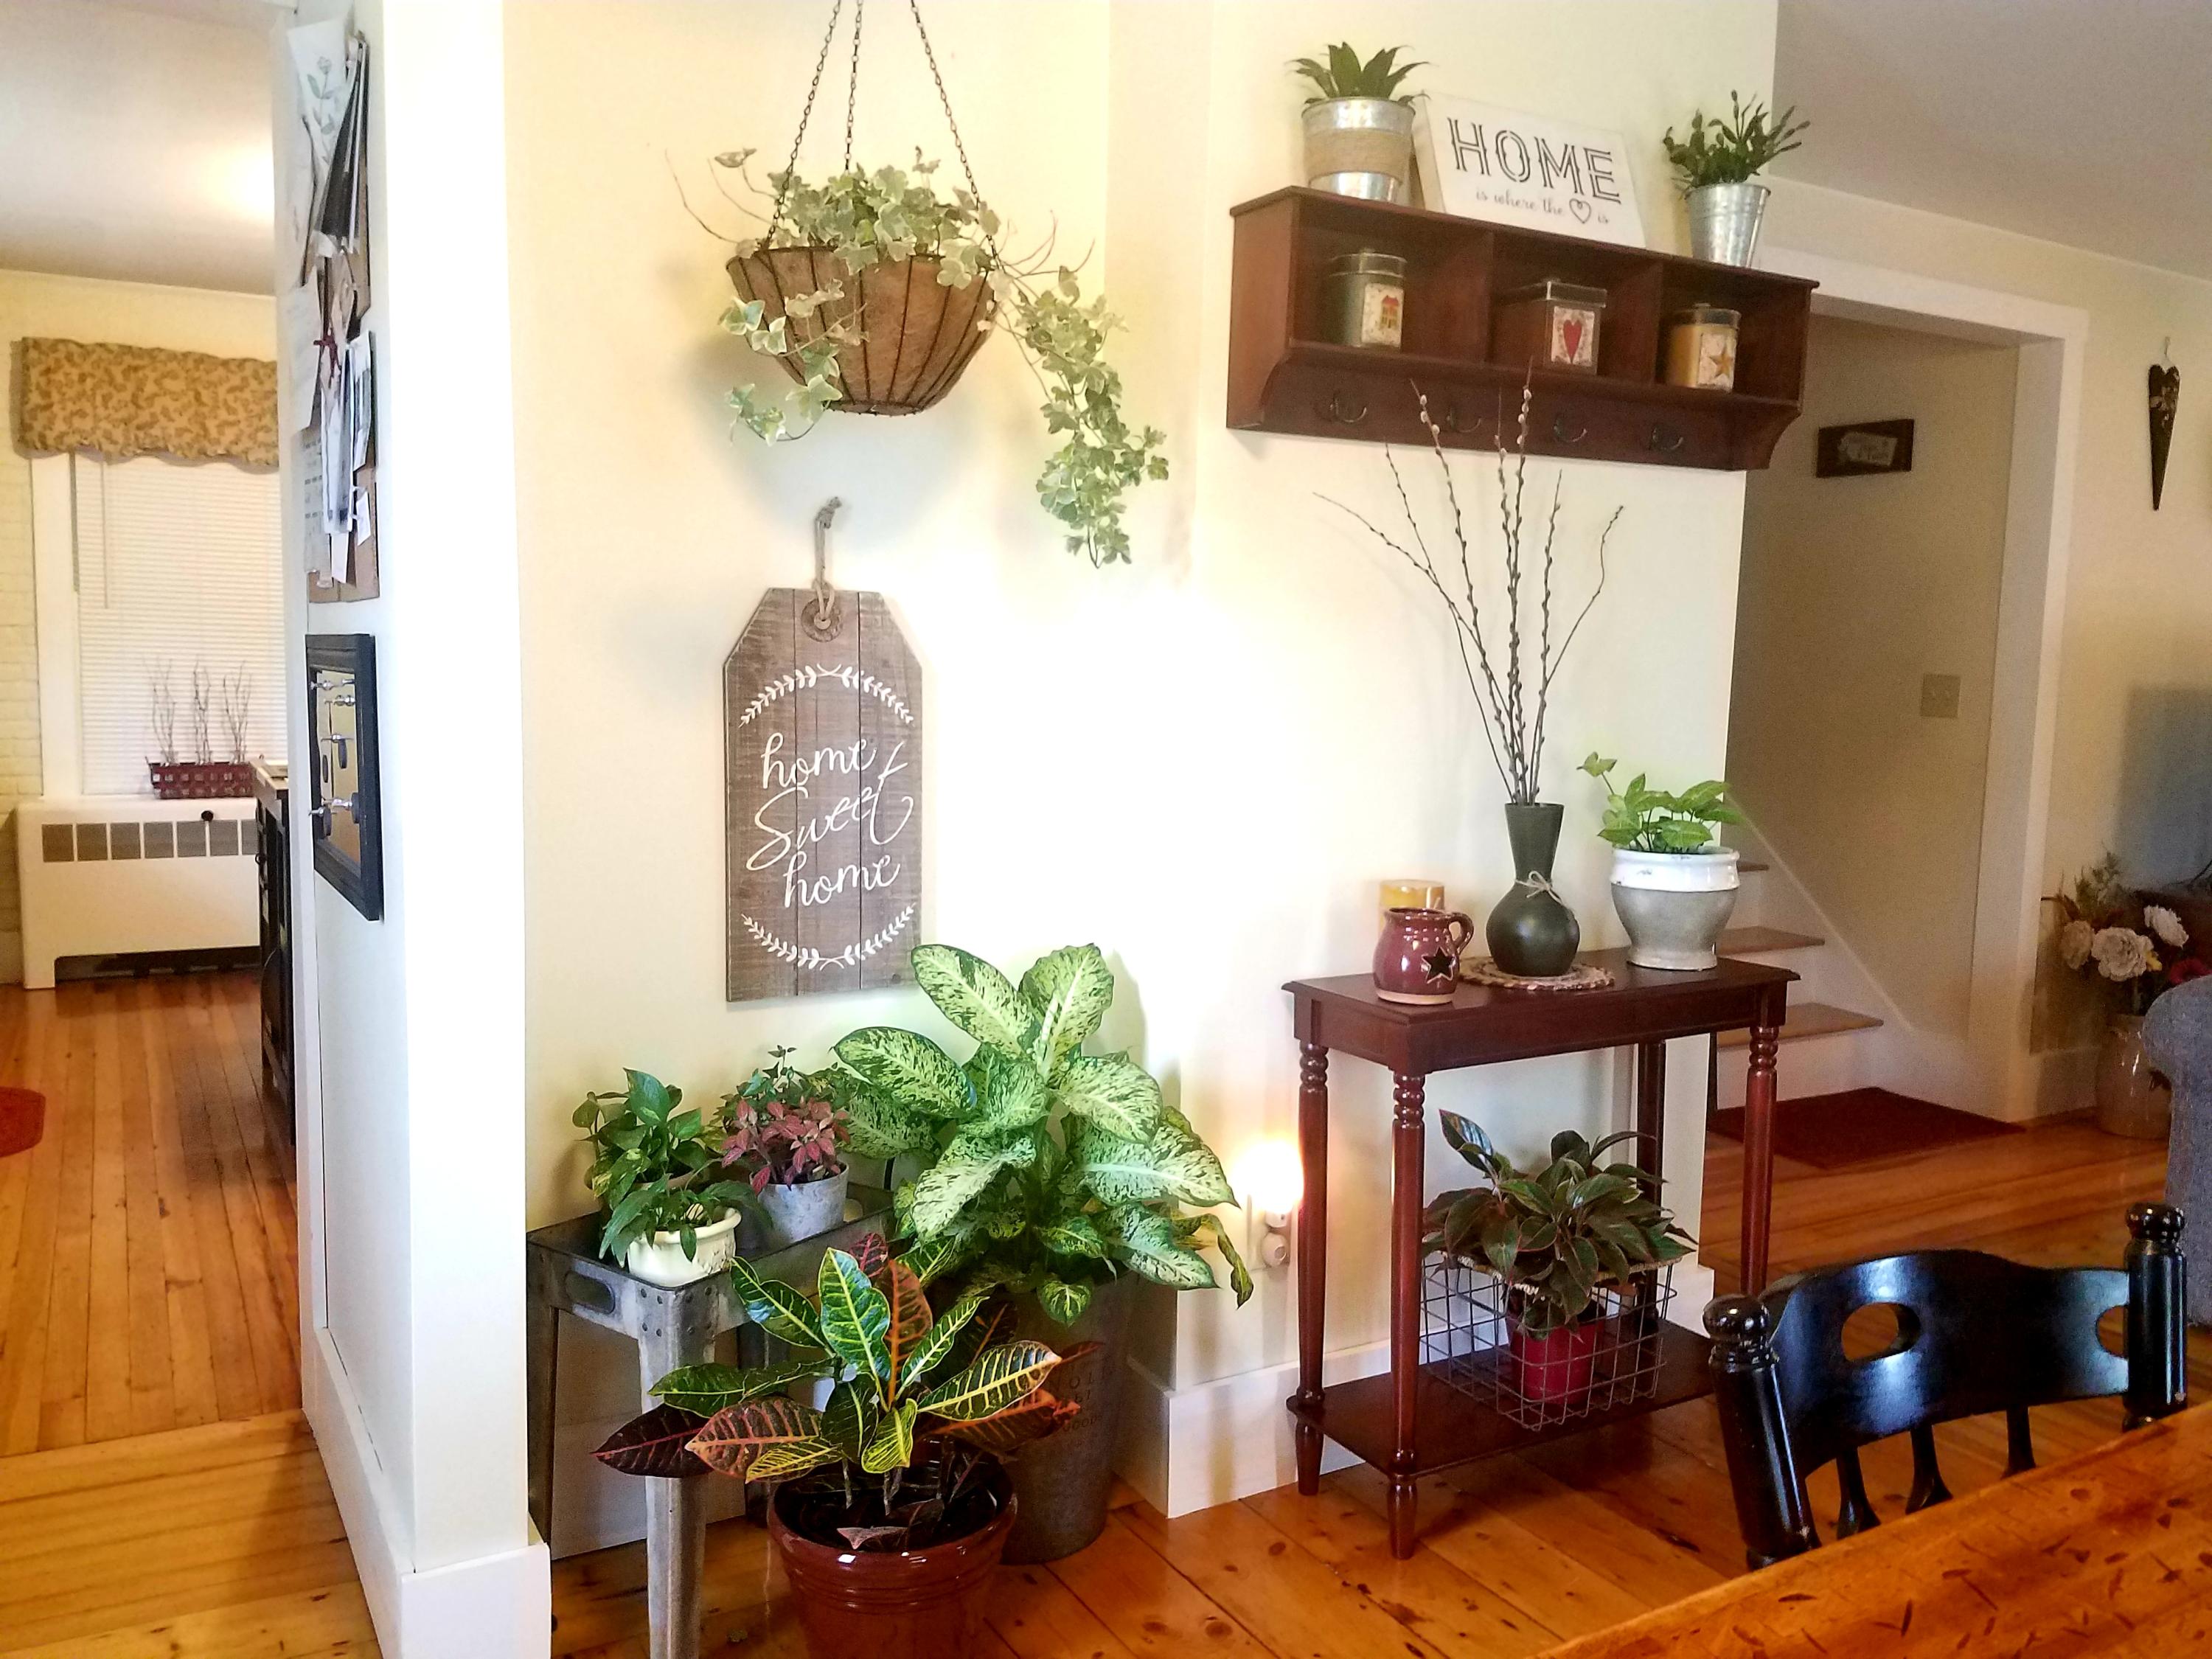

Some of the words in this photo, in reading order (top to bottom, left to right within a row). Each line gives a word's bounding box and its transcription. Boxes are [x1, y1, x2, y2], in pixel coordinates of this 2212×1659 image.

[1447, 117, 1621, 204] HOME
[1476, 190, 1489, 202] is
[1494, 188, 1537, 210] where
[1542, 197, 1564, 215] the
[1597, 213, 1610, 224] is
[761, 732, 877, 789] home
[746, 740, 914, 871] Sweet
[783, 851, 900, 908] home
